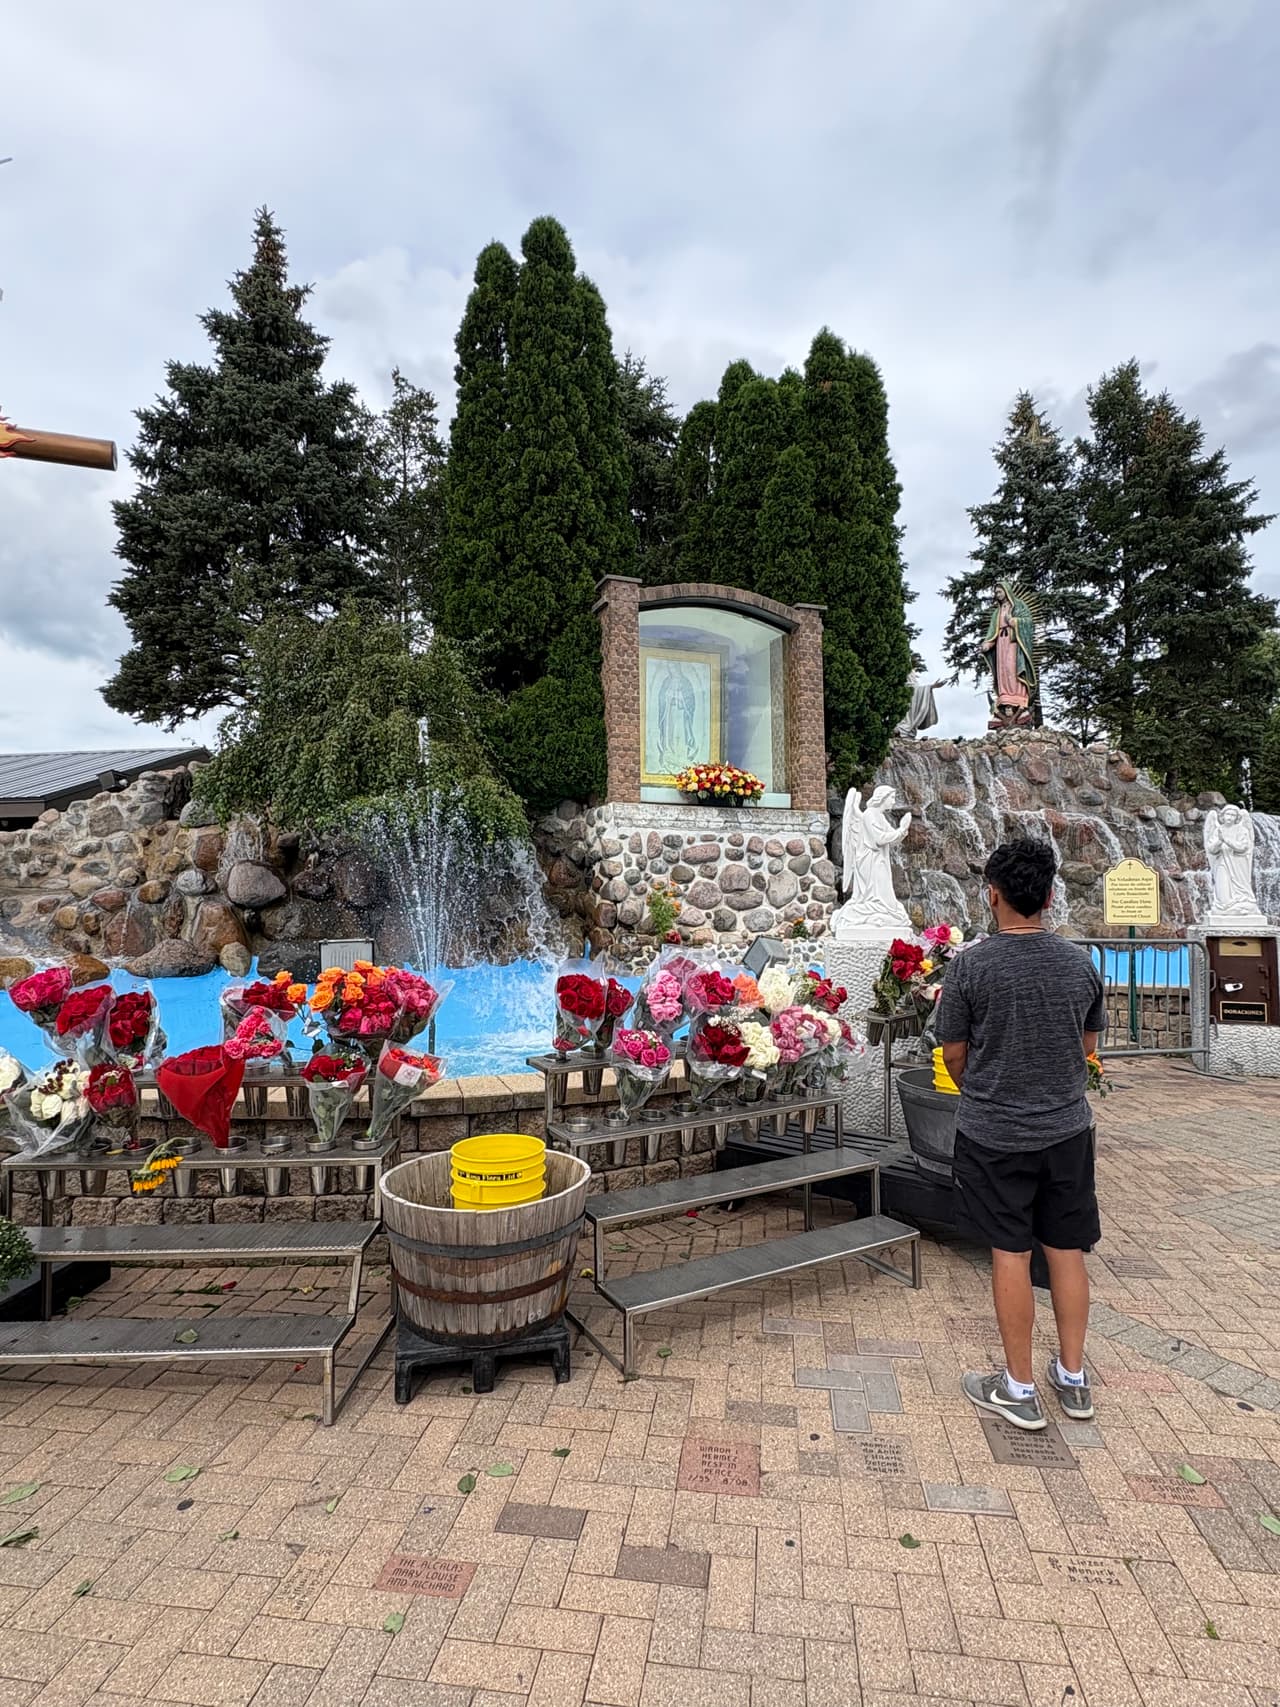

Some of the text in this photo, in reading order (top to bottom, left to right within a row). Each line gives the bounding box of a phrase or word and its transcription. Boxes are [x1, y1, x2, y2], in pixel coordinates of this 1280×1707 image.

[398, 1558, 465, 1574] THE ALCALAS
[391, 1566, 462, 1584] MARY LOUISE
[385, 1577, 457, 1593] AND RICHARD
